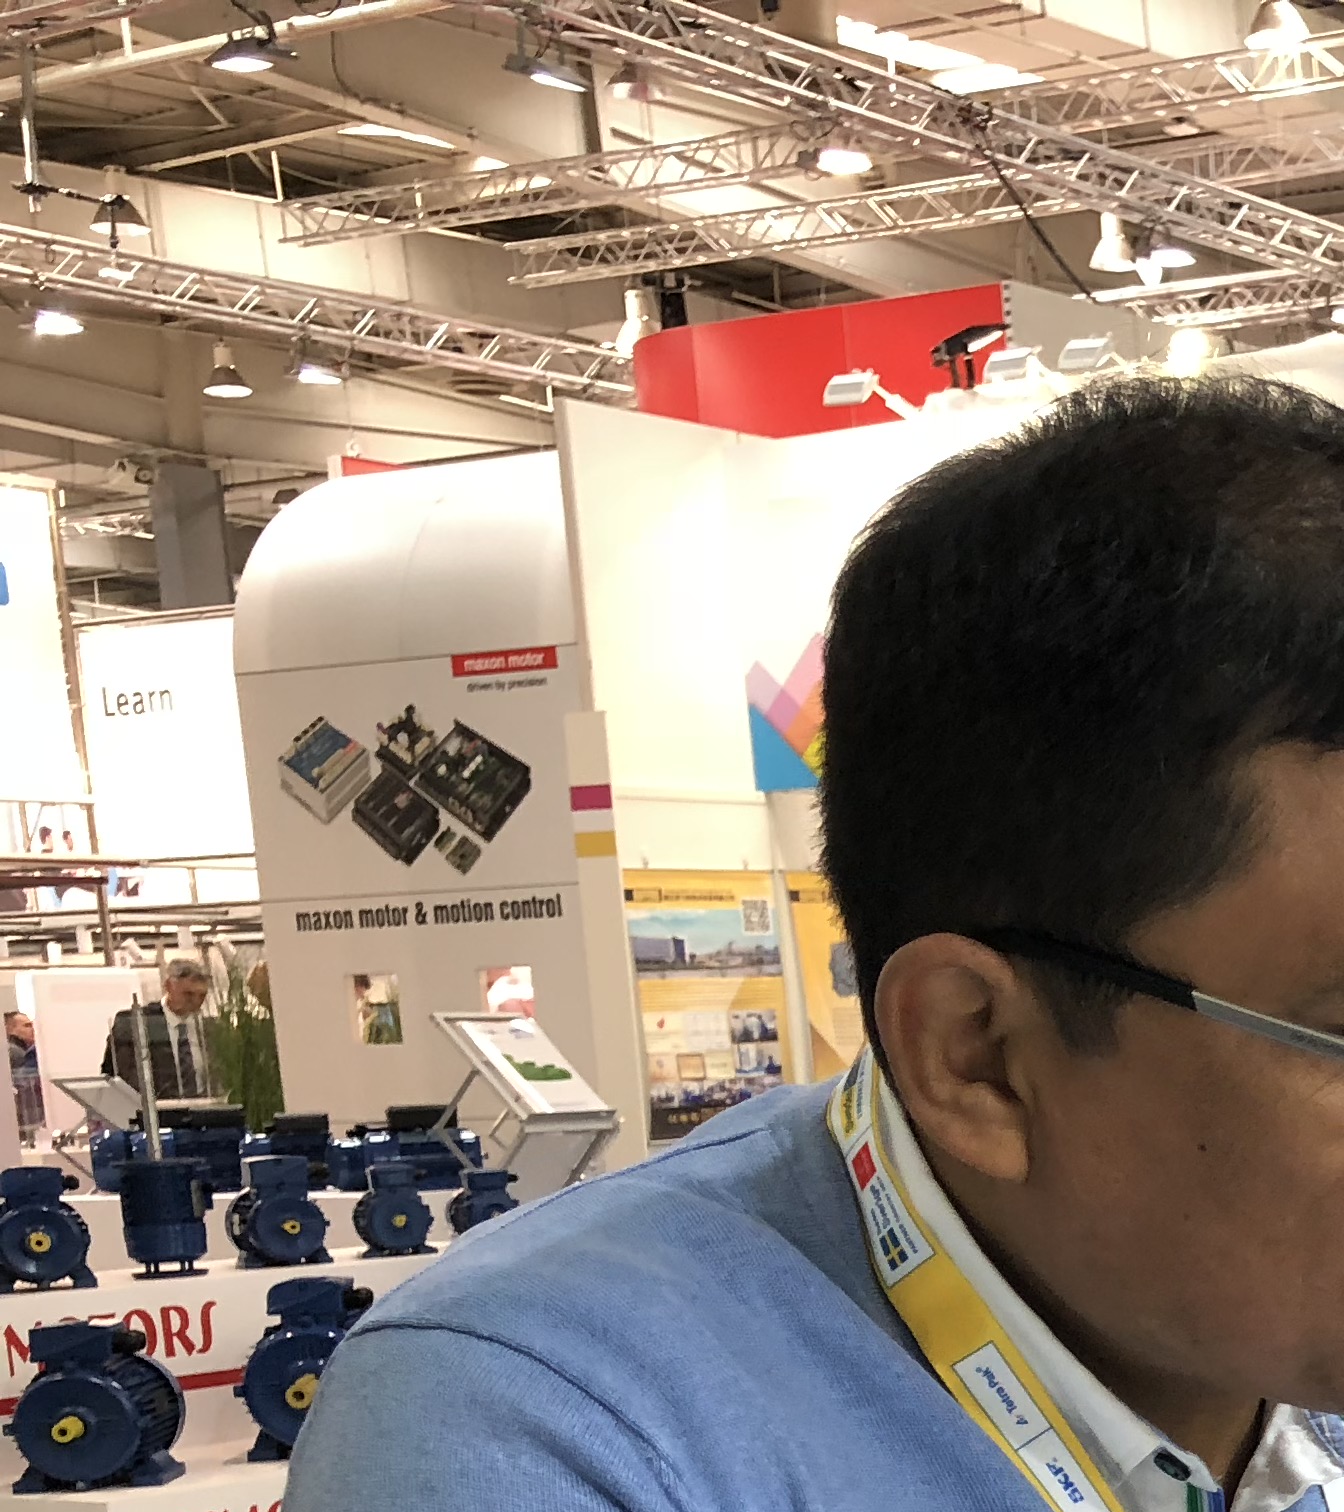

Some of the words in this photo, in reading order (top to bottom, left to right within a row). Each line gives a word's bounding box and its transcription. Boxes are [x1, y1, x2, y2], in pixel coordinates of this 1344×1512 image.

[102, 687, 173, 716] Learn
[295, 908, 355, 932] maxon
[358, 904, 409, 929] motor
[415, 901, 428, 926] &
[433, 898, 496, 925] motion
[499, 893, 563, 921] control
[3, 1300, 218, 1378] MORS
[996, 1386, 1017, 1414] Tetra
[1046, 1458, 1084, 1503] SKF
